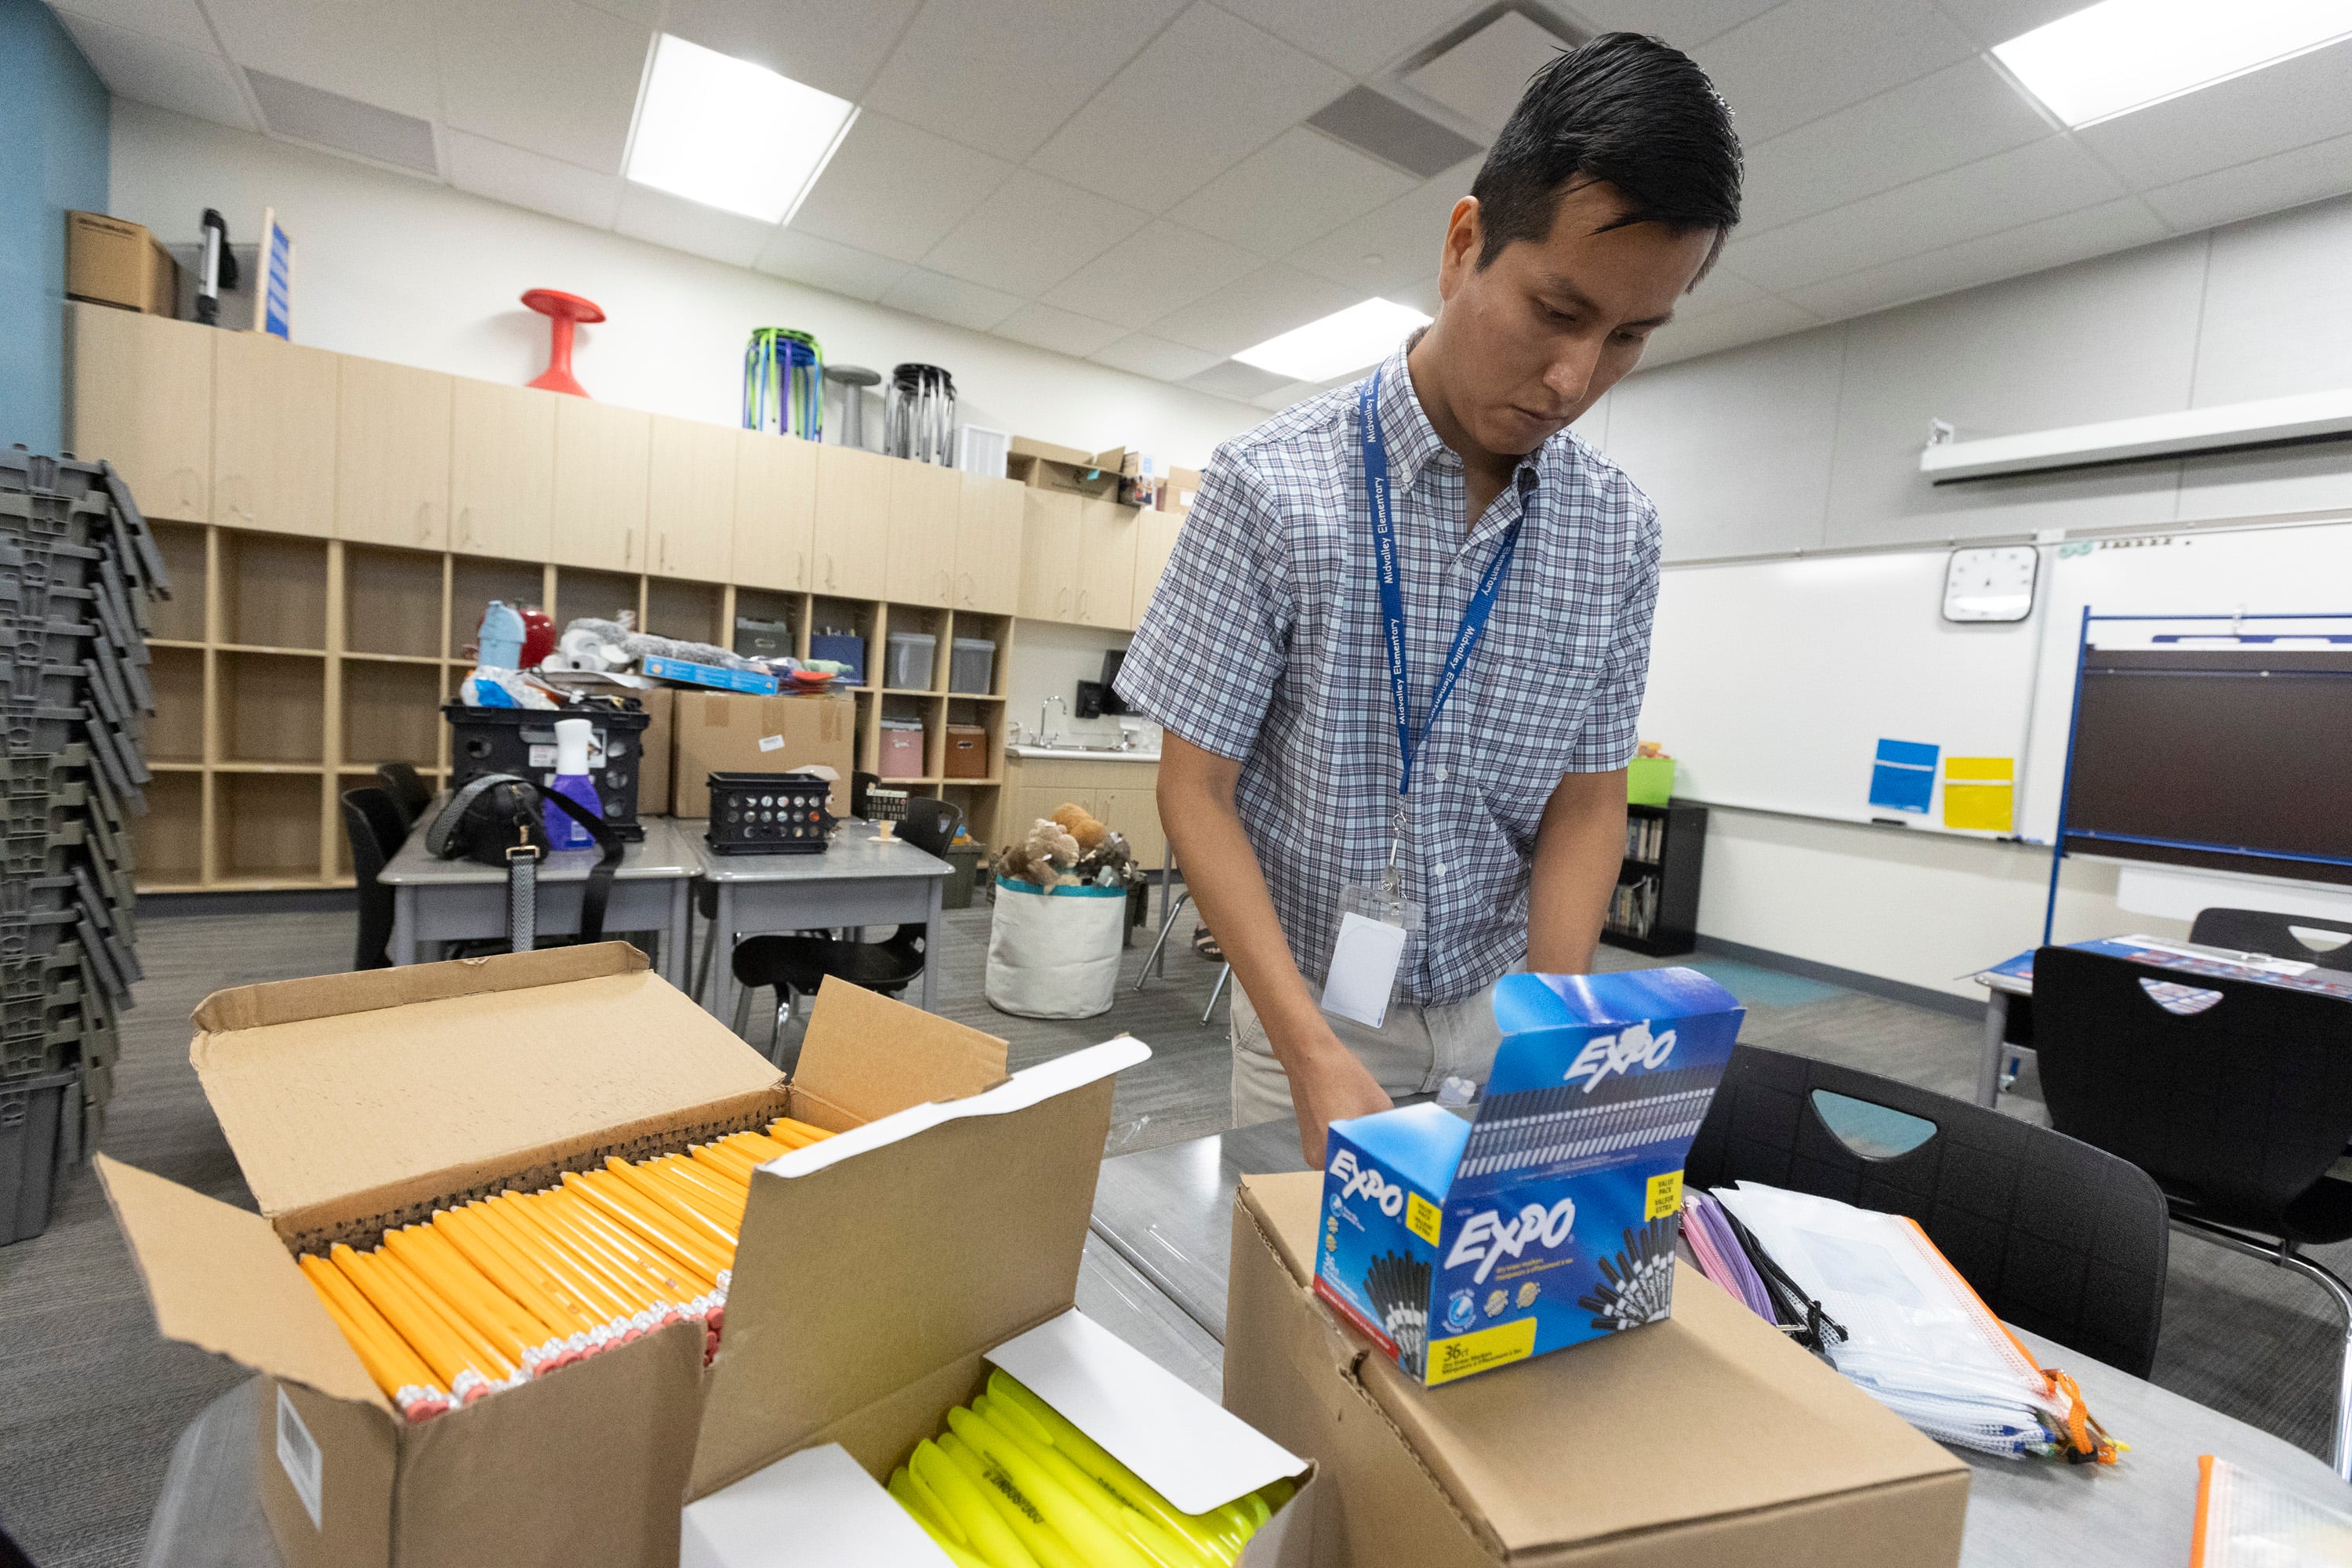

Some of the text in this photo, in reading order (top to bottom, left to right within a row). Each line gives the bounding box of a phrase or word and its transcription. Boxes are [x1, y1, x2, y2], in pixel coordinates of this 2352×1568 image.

[1365, 398, 1376, 442] Midvalley
[1374, 477, 1393, 584] Midvalley Elementary
[1481, 546, 1512, 596] Elementary
[1392, 618, 1406, 725] Midvalley Elementary
[1428, 626, 1475, 724] Midvalley Elementary
[1563, 1028, 1677, 1094] EXPO
[1329, 1149, 1403, 1218] EXPO
[1444, 1198, 1575, 1284] EXPO
